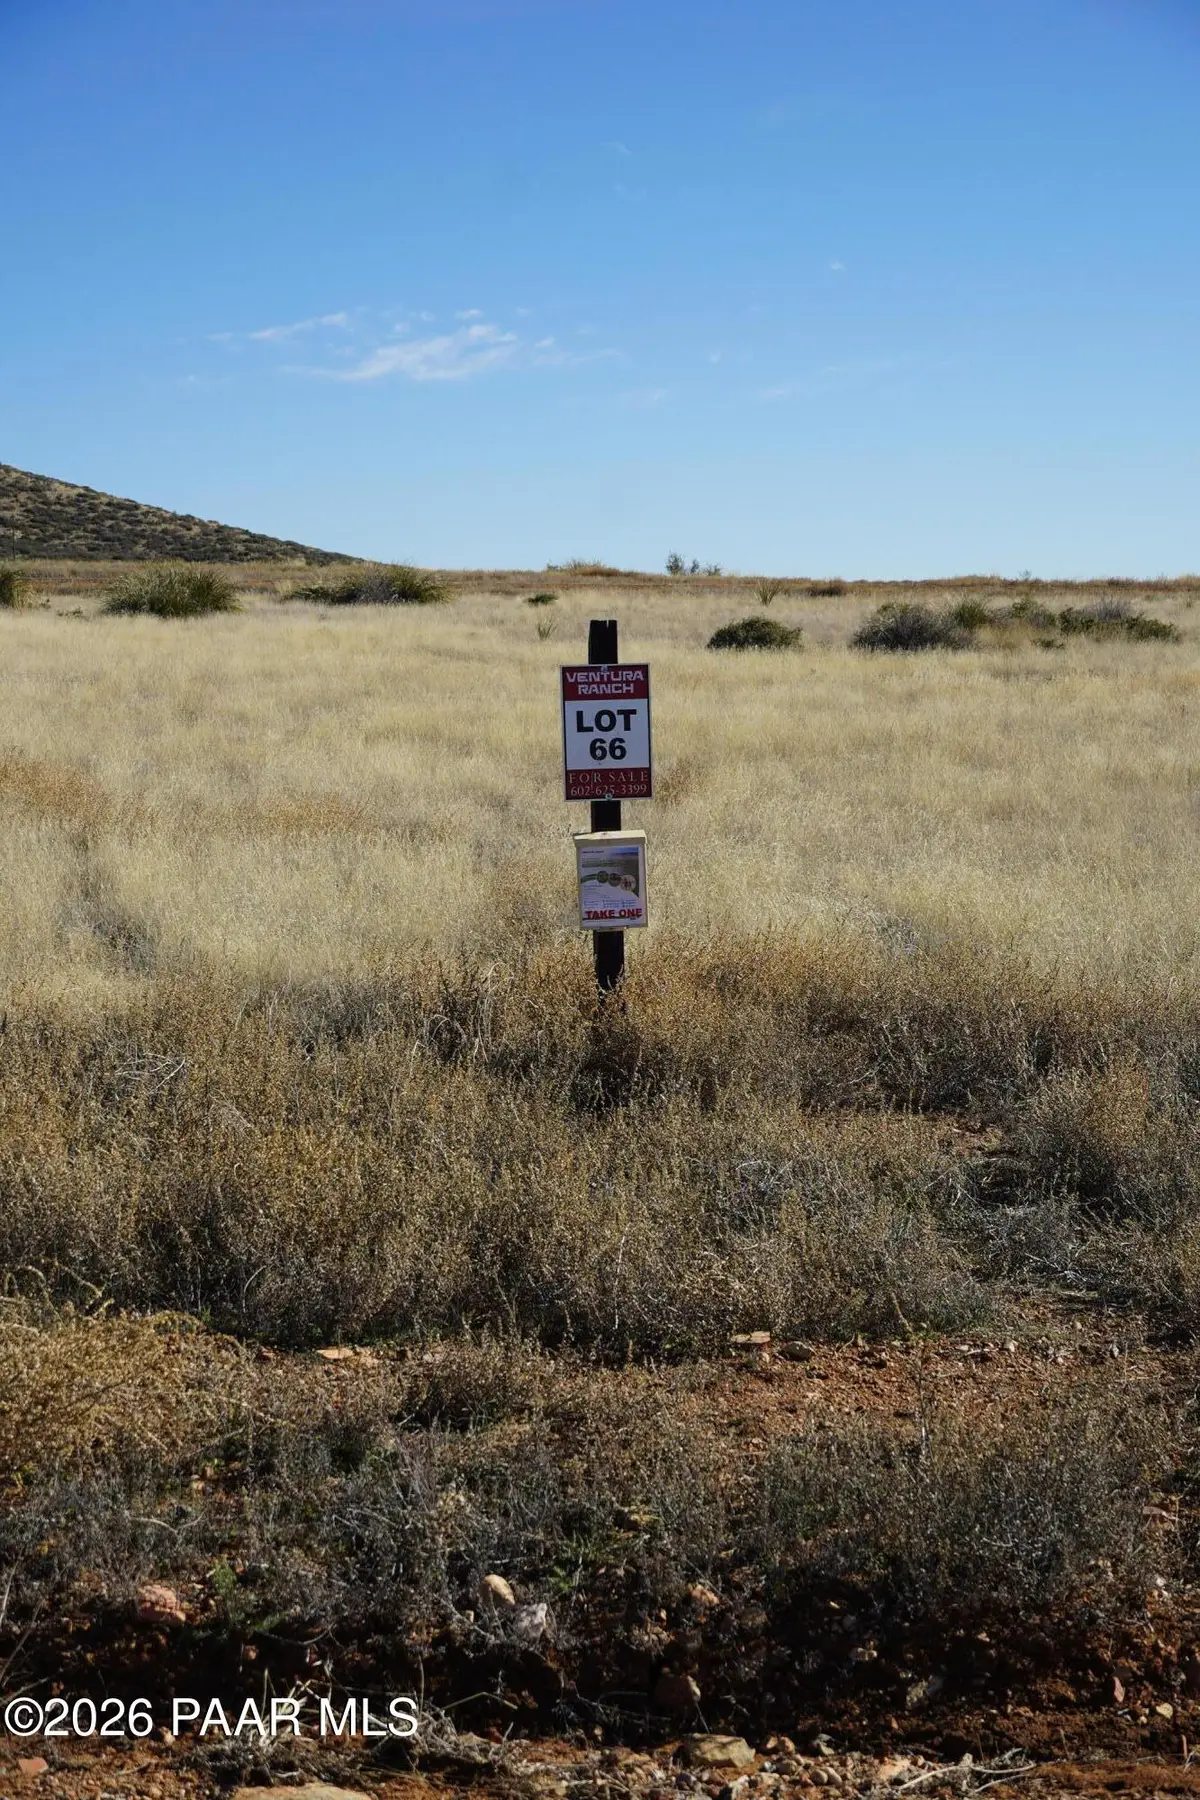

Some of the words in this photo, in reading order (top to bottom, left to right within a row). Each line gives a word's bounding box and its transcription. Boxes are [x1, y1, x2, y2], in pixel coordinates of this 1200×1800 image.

[566, 670, 644, 683] VENTURA
[578, 683, 634, 695] RANCH
[576, 709, 637, 732] LOT
[589, 737, 627, 761] 66
[569, 772, 602, 784] FOR
[608, 770, 648, 782] SALE
[585, 909, 616, 920] TAKE
[618, 908, 643, 918] ONE
